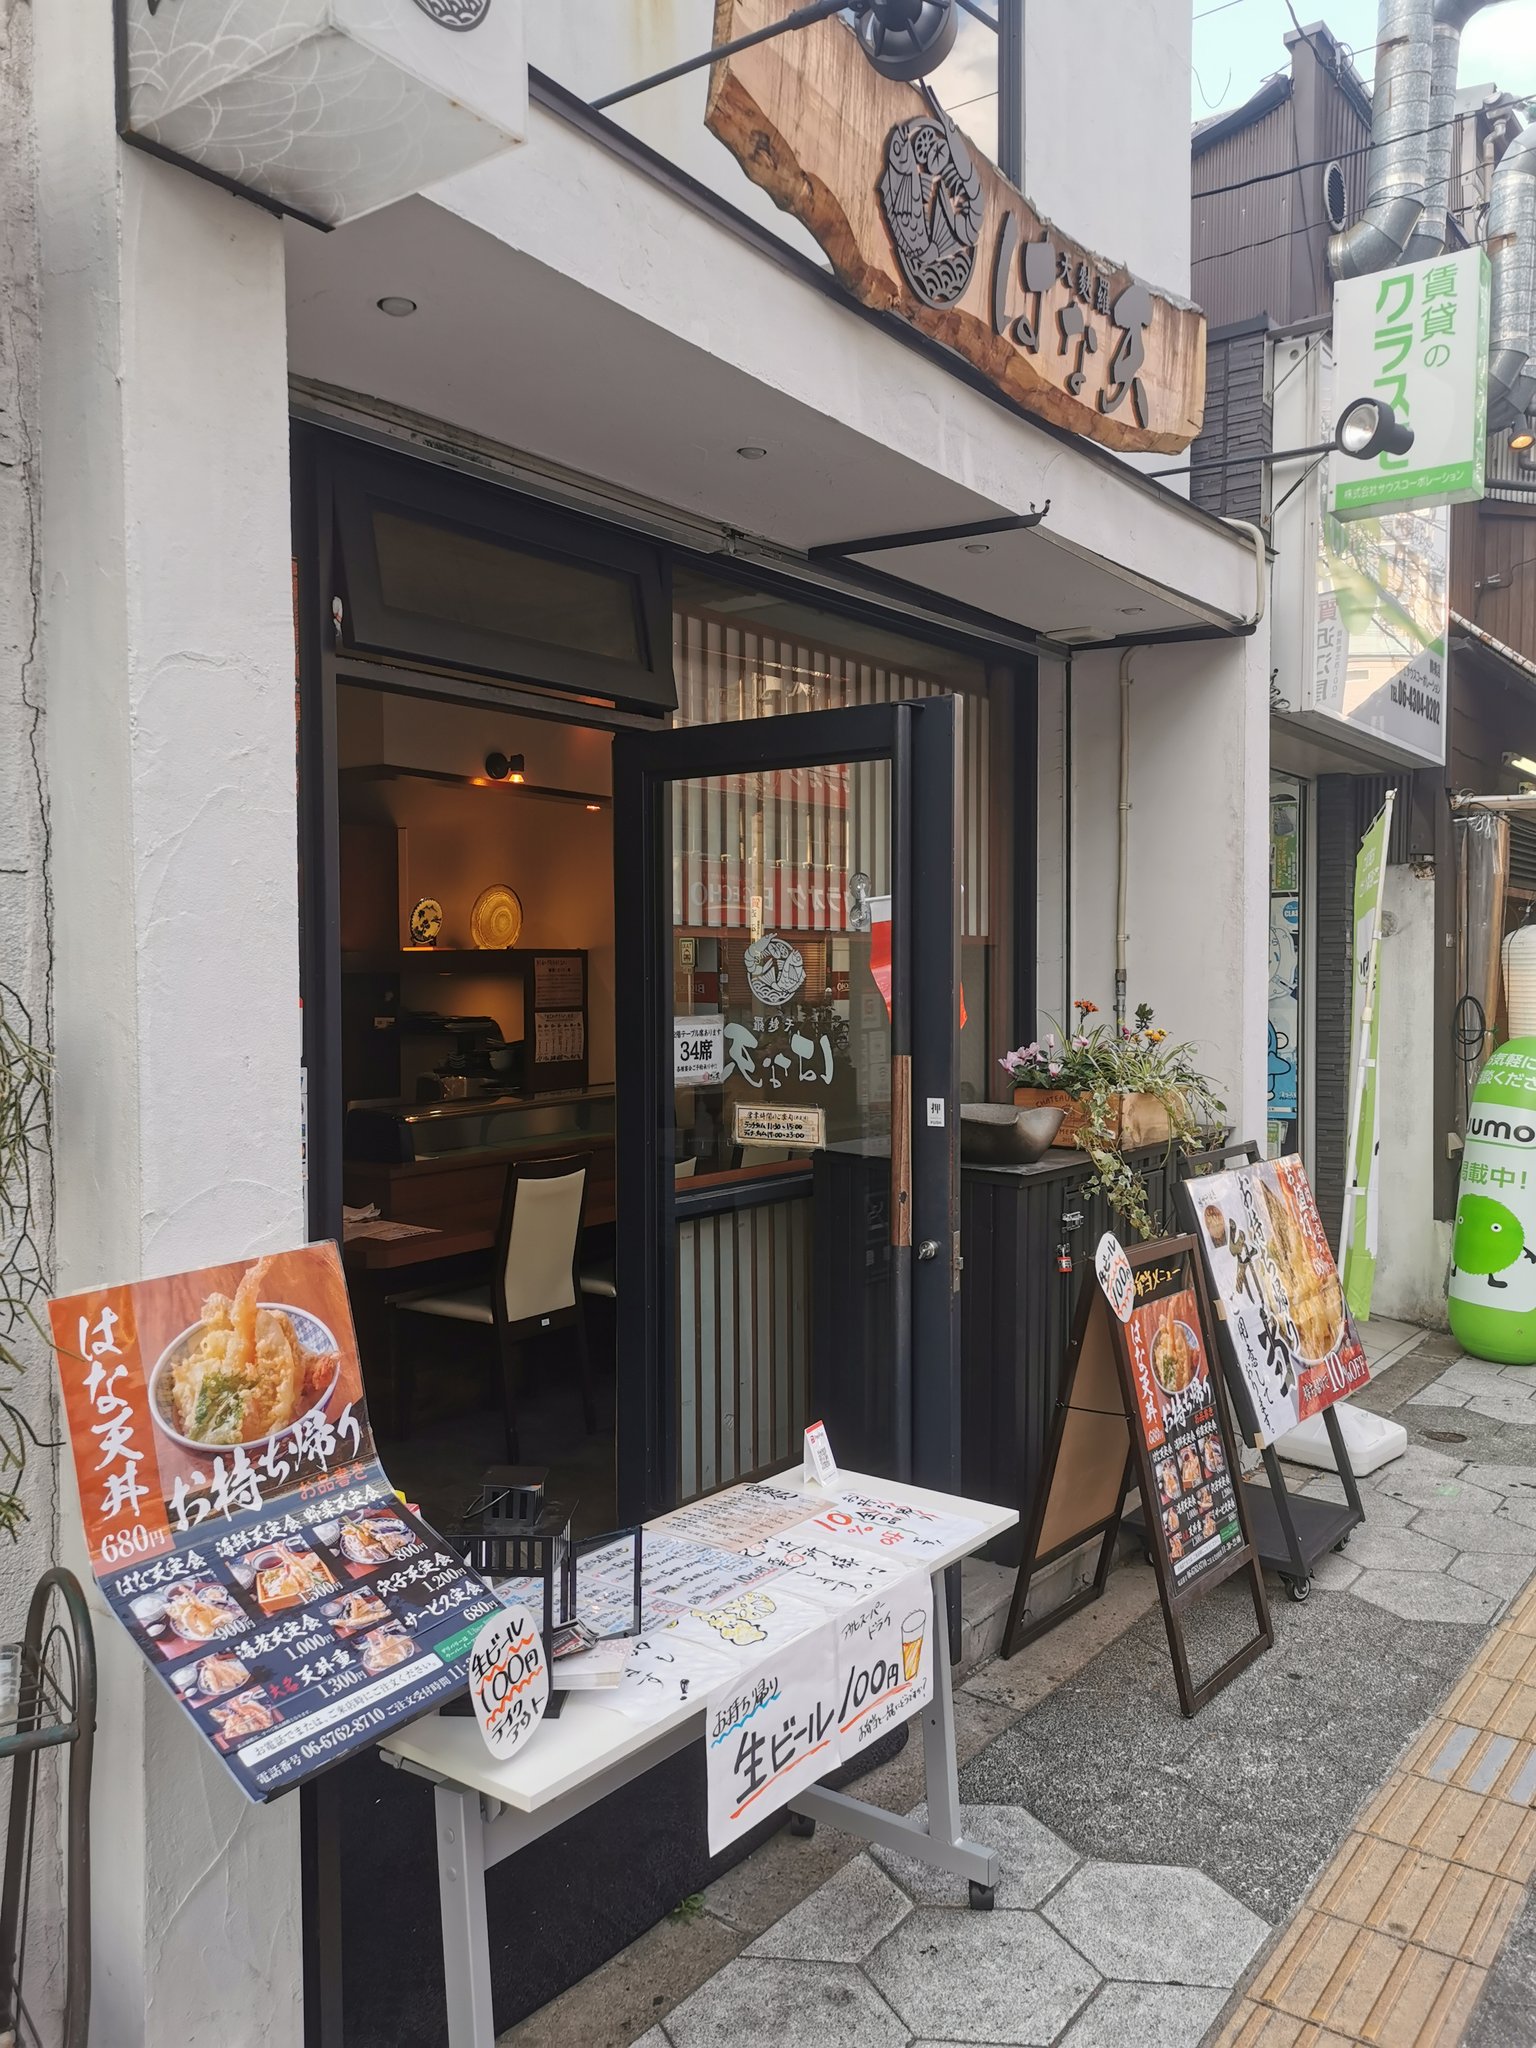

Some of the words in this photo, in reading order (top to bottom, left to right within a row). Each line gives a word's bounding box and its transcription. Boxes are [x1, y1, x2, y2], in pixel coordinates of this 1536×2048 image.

[994, 210, 1153, 428] はな天
[1420, 263, 1459, 368] 賃貸の
[1344, 470, 1465, 499] 株式会社サウスコーポレーション
[680, 1040, 713, 1062] 34席
[930, 1102, 941, 1114] 押
[1132, 1267, 1181, 1297] 弁当メニュー
[1131, 1320, 1158, 1423] はな天丼
[79, 1306, 149, 1521] はな天丼
[170, 1402, 361, 1531] お持ち帰り
[299, 1461, 368, 1500] お品書き
[303, 1484, 383, 1523] 野菜天定食
[100, 1523, 167, 1564] 680円
[215, 1513, 303, 1558] 海鮮天定食
[115, 1549, 208, 1597] はな天定食
[376, 1551, 454, 1598] 穴子天定食
[421, 1567, 467, 1593] 1,200円
[404, 1580, 484, 1633] サービス定食
[463, 1599, 499, 1622] 680円
[842, 1601, 886, 1640] アサヒスーパー
[868, 1611, 892, 1640] ドライ
[215, 1618, 256, 1641] 900円
[235, 1613, 323, 1661] 海老天定食
[284, 1632, 335, 1662] 1,000円
[472, 1618, 524, 1684] 生ビール
[315, 1669, 368, 1700] 1,300円
[712, 1676, 780, 1738] お持ち帰り
[837, 1659, 899, 1724] 100円
[256, 1754, 302, 1785] 電話番号
[301, 1707, 386, 1759] 06-6762-8710
[386, 1675, 452, 1716] ご注文受付時間
[491, 1699, 523, 1744] テイク
[506, 1696, 545, 1744] アウト
[734, 1701, 836, 1804] 生ビール
